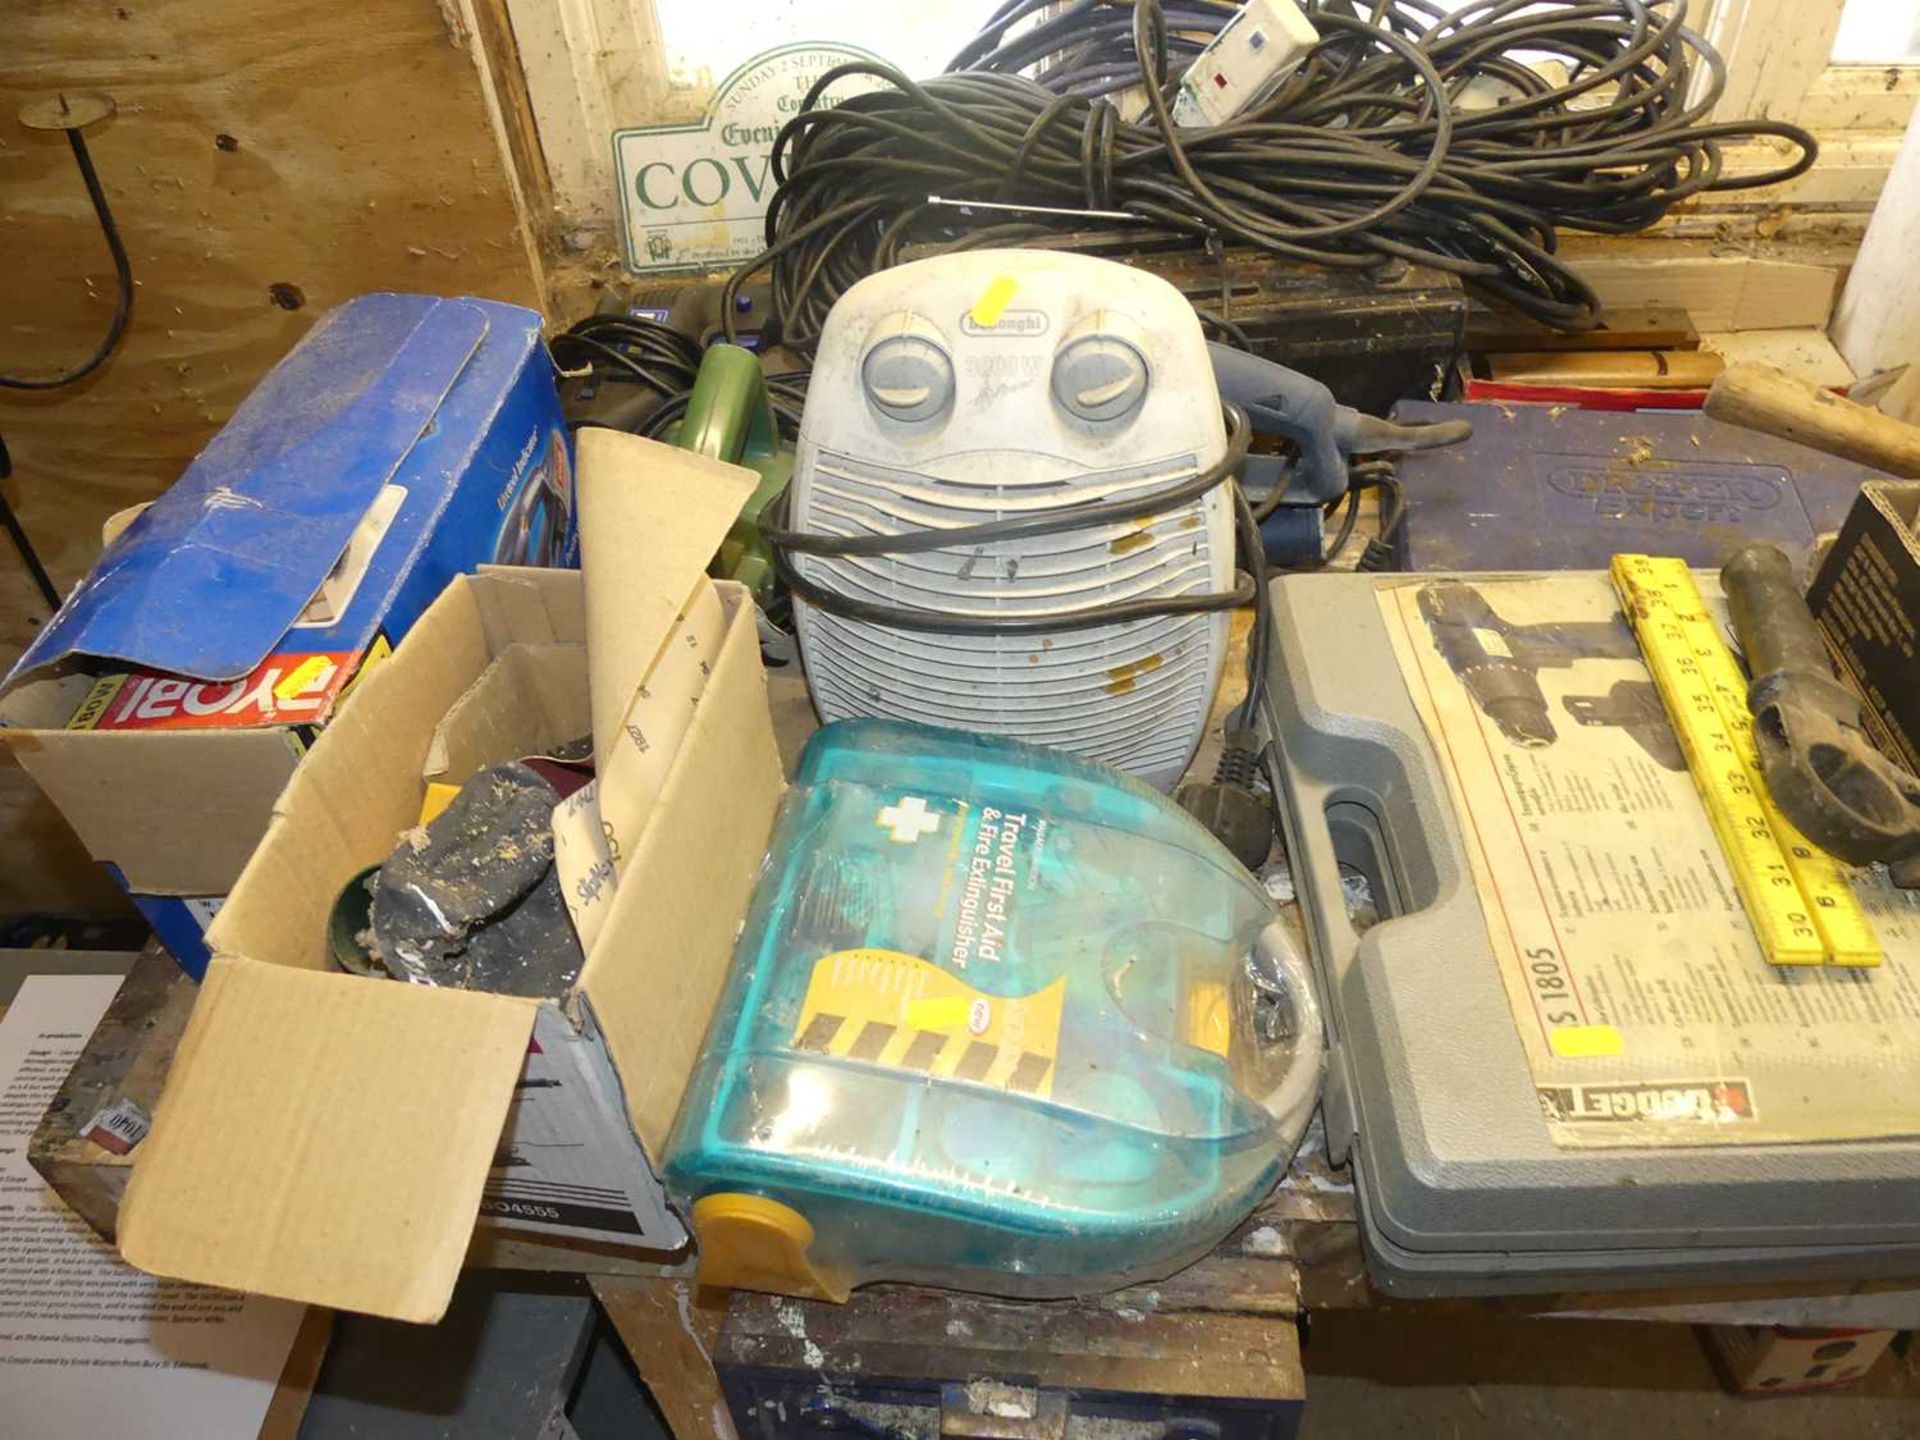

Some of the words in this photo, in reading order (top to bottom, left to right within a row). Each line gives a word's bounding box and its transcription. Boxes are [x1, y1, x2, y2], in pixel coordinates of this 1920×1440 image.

[726, 61, 778, 113] SUNDAY
[982, 806, 1002, 820] &
[975, 824, 999, 857] Fire
[995, 812, 1027, 878] Travel
[952, 857, 991, 969] Extinguisher
[986, 876, 1016, 927] First
[977, 925, 1005, 962] Aid
[1527, 947, 1571, 1001] 1805
